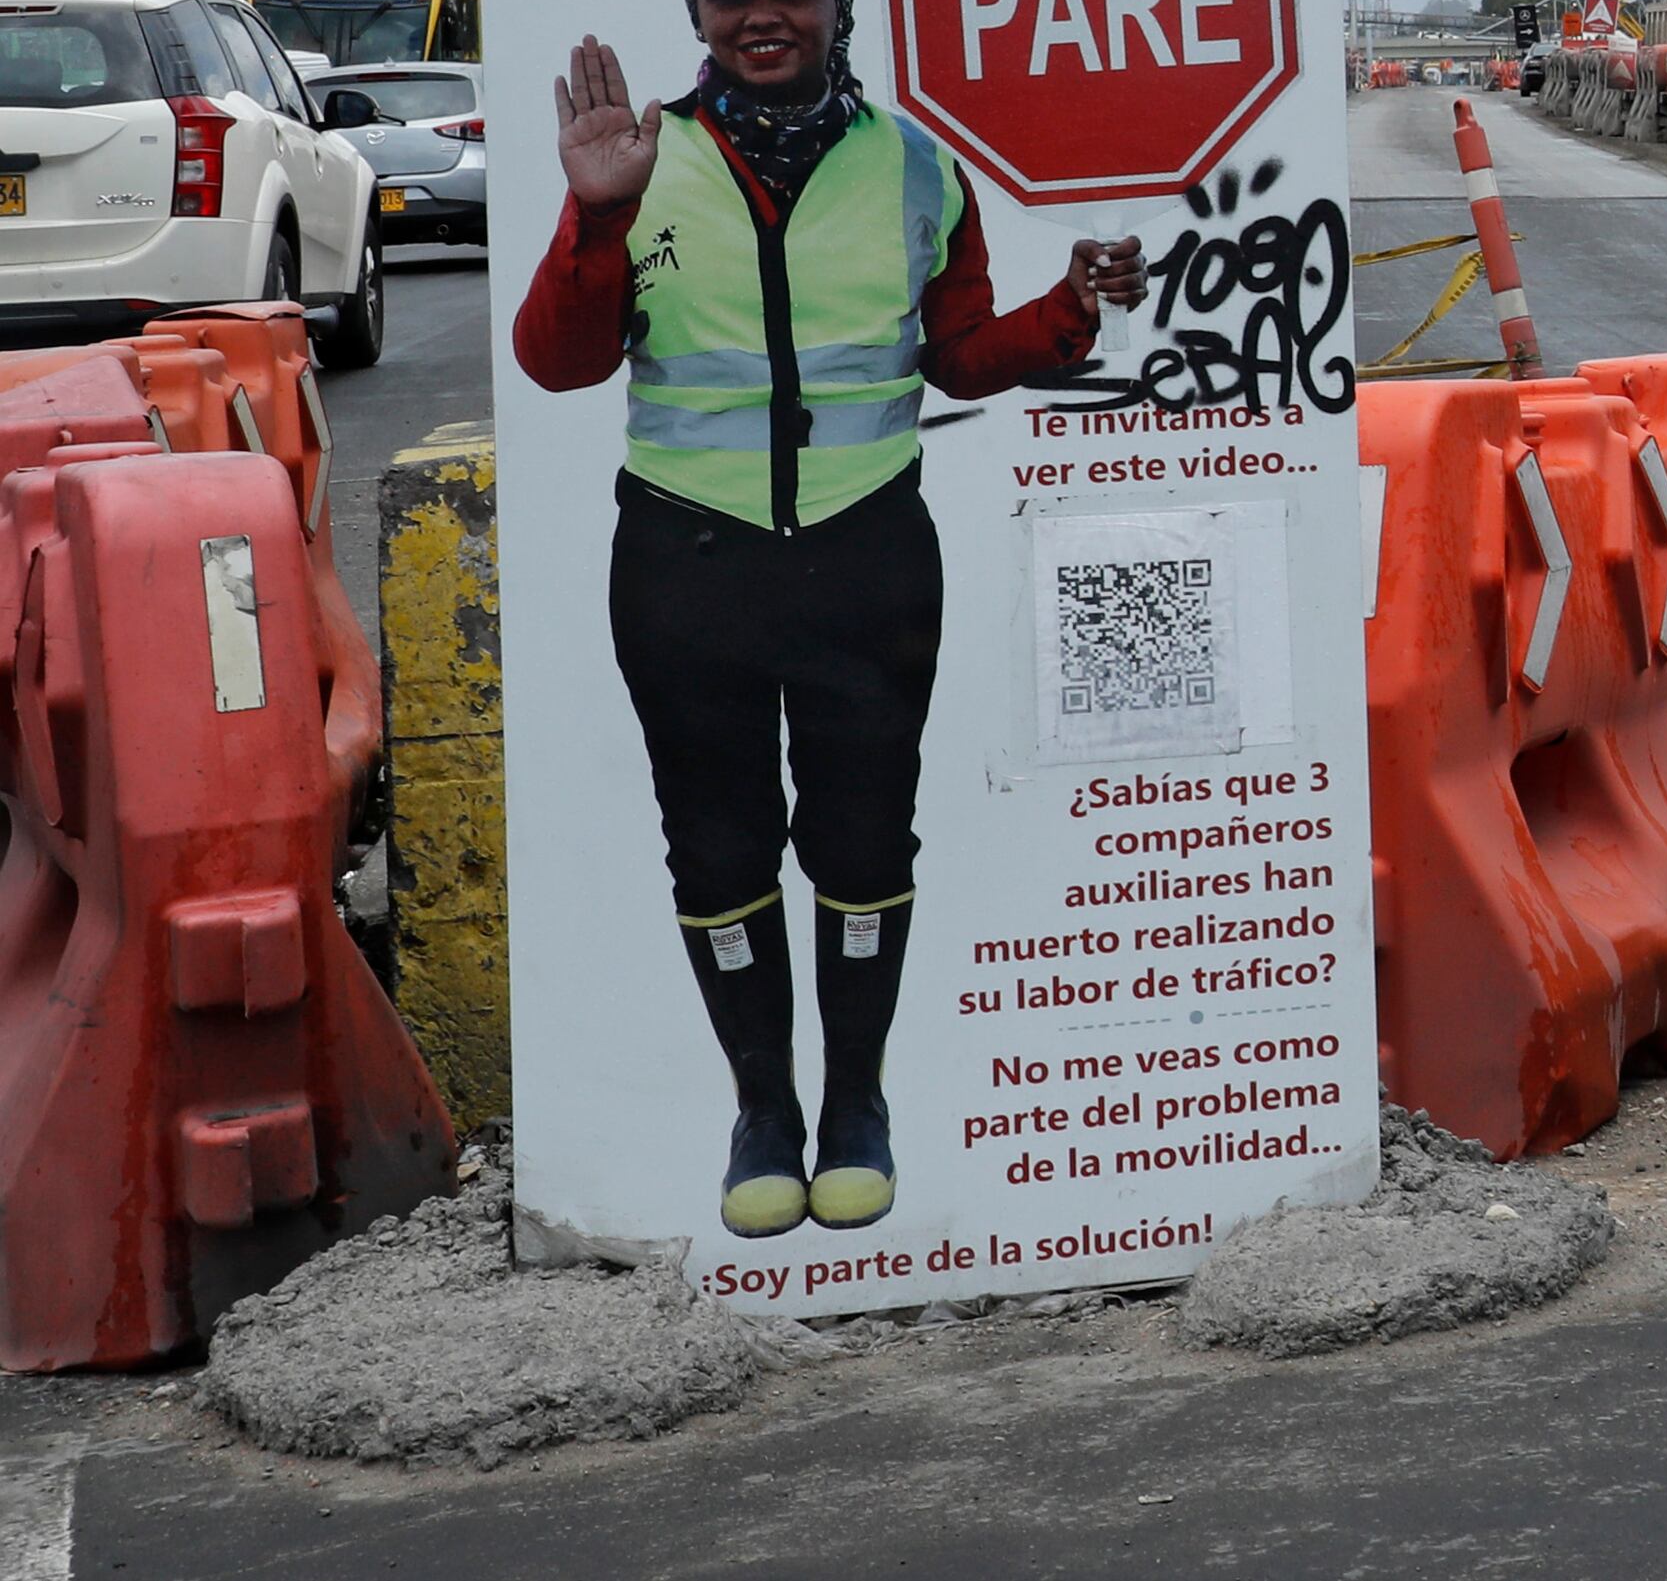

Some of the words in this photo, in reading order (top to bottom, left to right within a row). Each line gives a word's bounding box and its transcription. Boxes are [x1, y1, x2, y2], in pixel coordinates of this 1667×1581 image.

[1024, 407, 1068, 438] Te
[1082, 403, 1271, 435] invitamos
[1284, 406, 1304, 425] a
[1012, 462, 1075, 487] ver
[1088, 453, 1167, 482] este
[1179, 446, 1318, 479] video...
[1070, 772, 1212, 818] ¿Sabías
[1224, 768, 1297, 807] que
[1309, 763, 1330, 792] 3
[1095, 815, 1333, 858] compañeros
[1064, 869, 1251, 908] auxiliares
[1263, 861, 1334, 891] han
[974, 927, 1120, 964] muerto
[1133, 906, 1335, 950] realizando
[958, 989, 1002, 1015] su
[1016, 977, 1119, 1011] labor
[1132, 967, 1180, 998] de
[1192, 953, 1338, 995] tráfico?
[991, 1056, 1049, 1088] No
[1063, 1054, 1124, 1082] me
[1135, 1045, 1221, 1073] veas
[1233, 1033, 1340, 1065] como
[963, 1104, 1069, 1148] parte
[1082, 1094, 1142, 1128] del
[1155, 1080, 1341, 1131] problema
[1006, 1152, 1055, 1185] de
[1068, 1147, 1101, 1179] la
[1115, 1125, 1342, 1175] movilidad...
[804, 1249, 914, 1294] parte
[927, 1240, 976, 1272] de
[989, 1231, 1023, 1266] la
[1035, 1213, 1214, 1262] solución!
